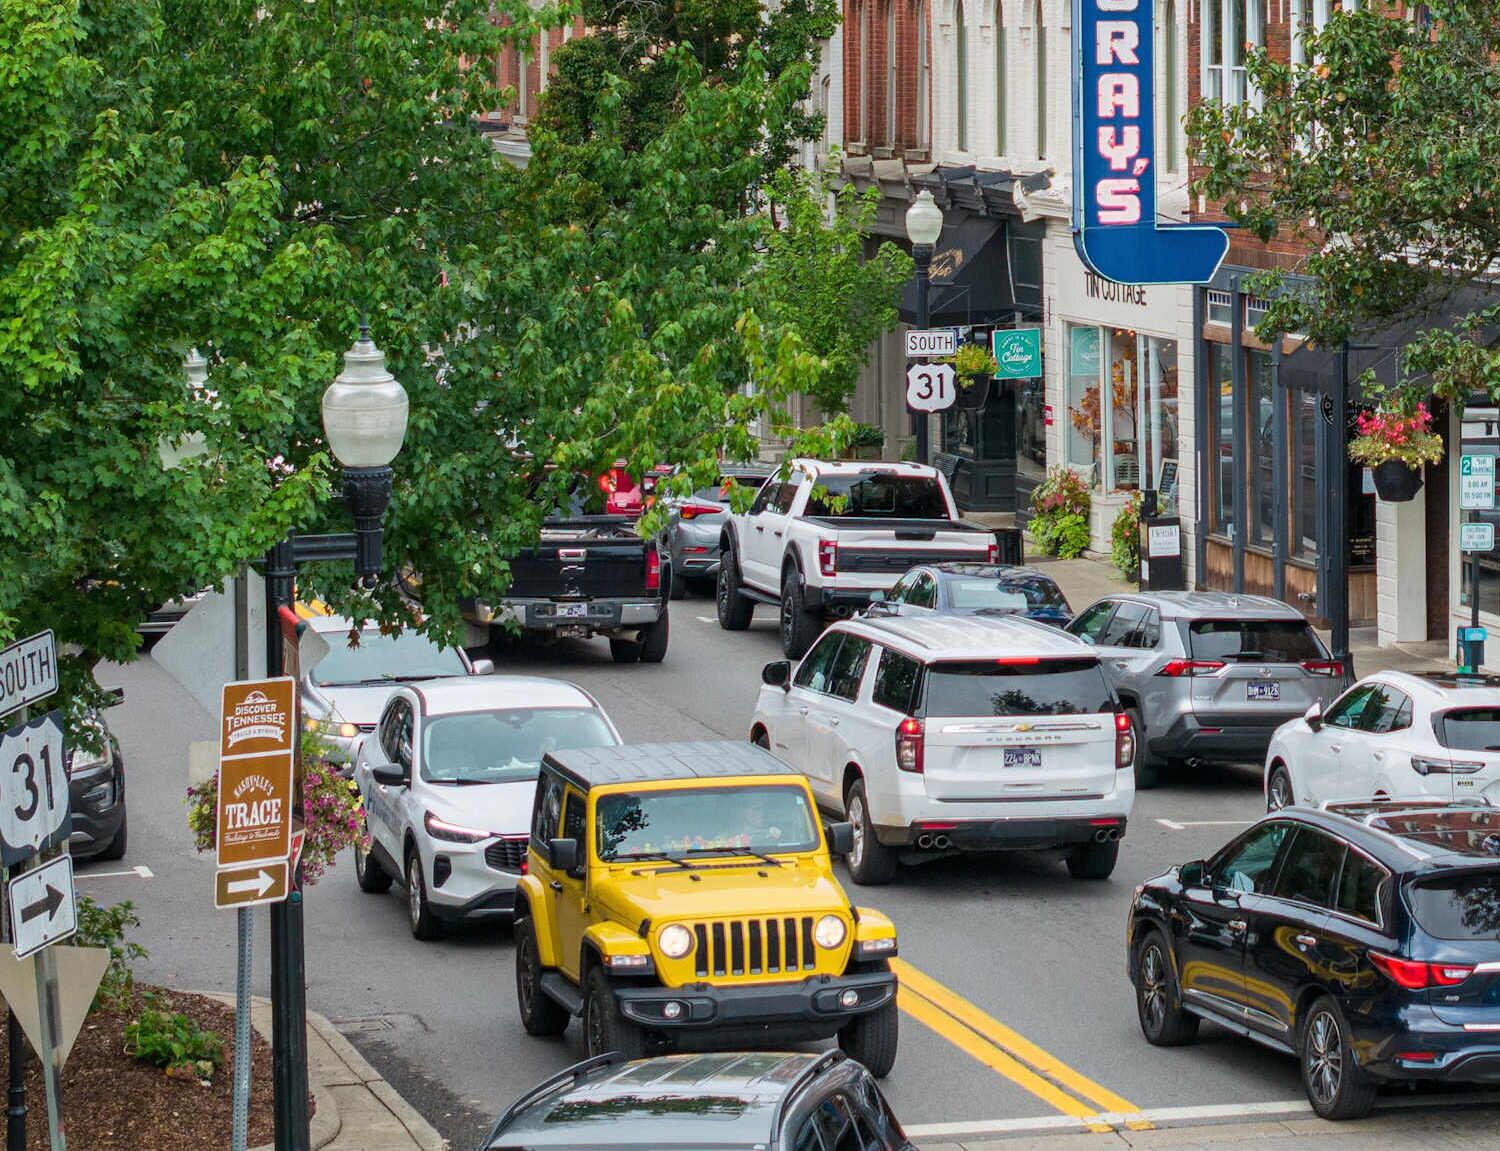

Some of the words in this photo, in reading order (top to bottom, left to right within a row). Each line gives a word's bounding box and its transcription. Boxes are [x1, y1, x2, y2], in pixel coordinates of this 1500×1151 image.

[1084, 271, 1100, 300] TIN
[909, 335, 953, 351] SOUTH
[916, 373, 945, 400] 31
[1462, 457, 1471, 474] 2
[235, 704, 277, 715] DISCOVER
[225, 713, 286, 732] TENNESSEE
[13, 744, 54, 822] 31
[225, 799, 281, 829] TRACE
